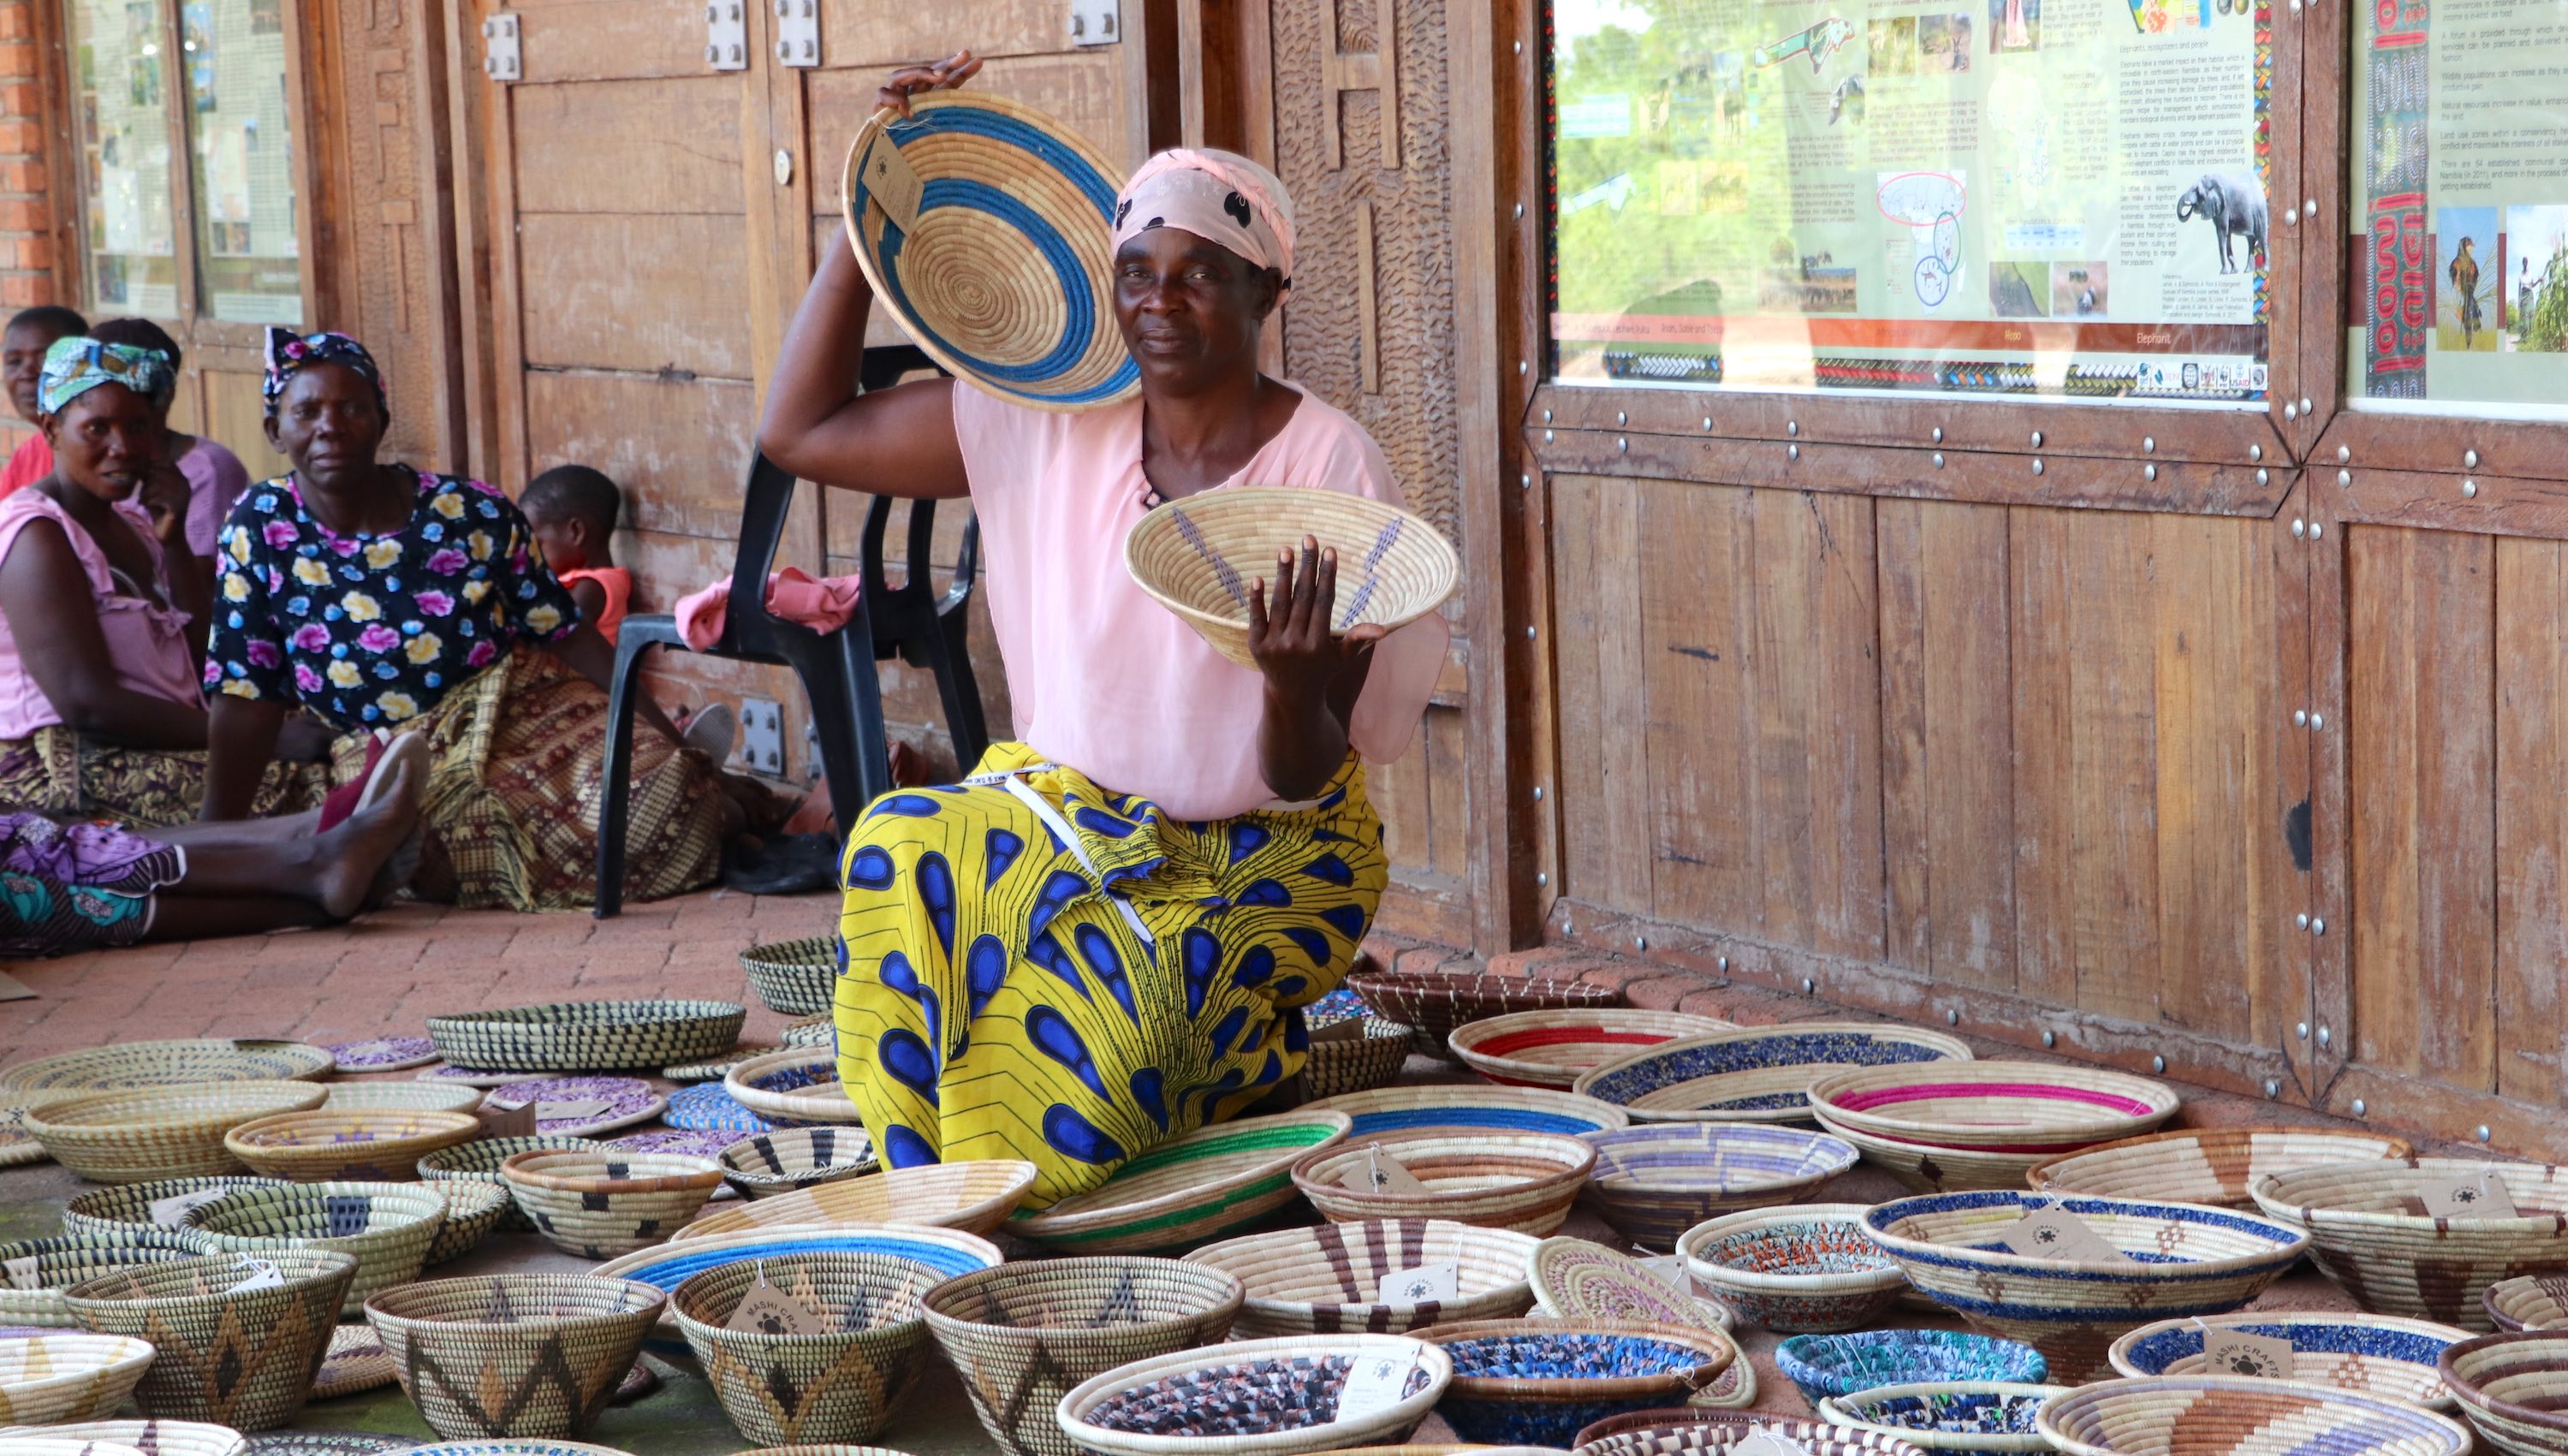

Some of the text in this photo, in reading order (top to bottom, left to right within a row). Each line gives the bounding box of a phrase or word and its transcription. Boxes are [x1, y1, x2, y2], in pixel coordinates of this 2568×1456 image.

[2137, 332, 2172, 346] Elephant
[747, 1301, 778, 1317] MASHI
[2215, 1344, 2280, 1379] MASHI CRAFTS
